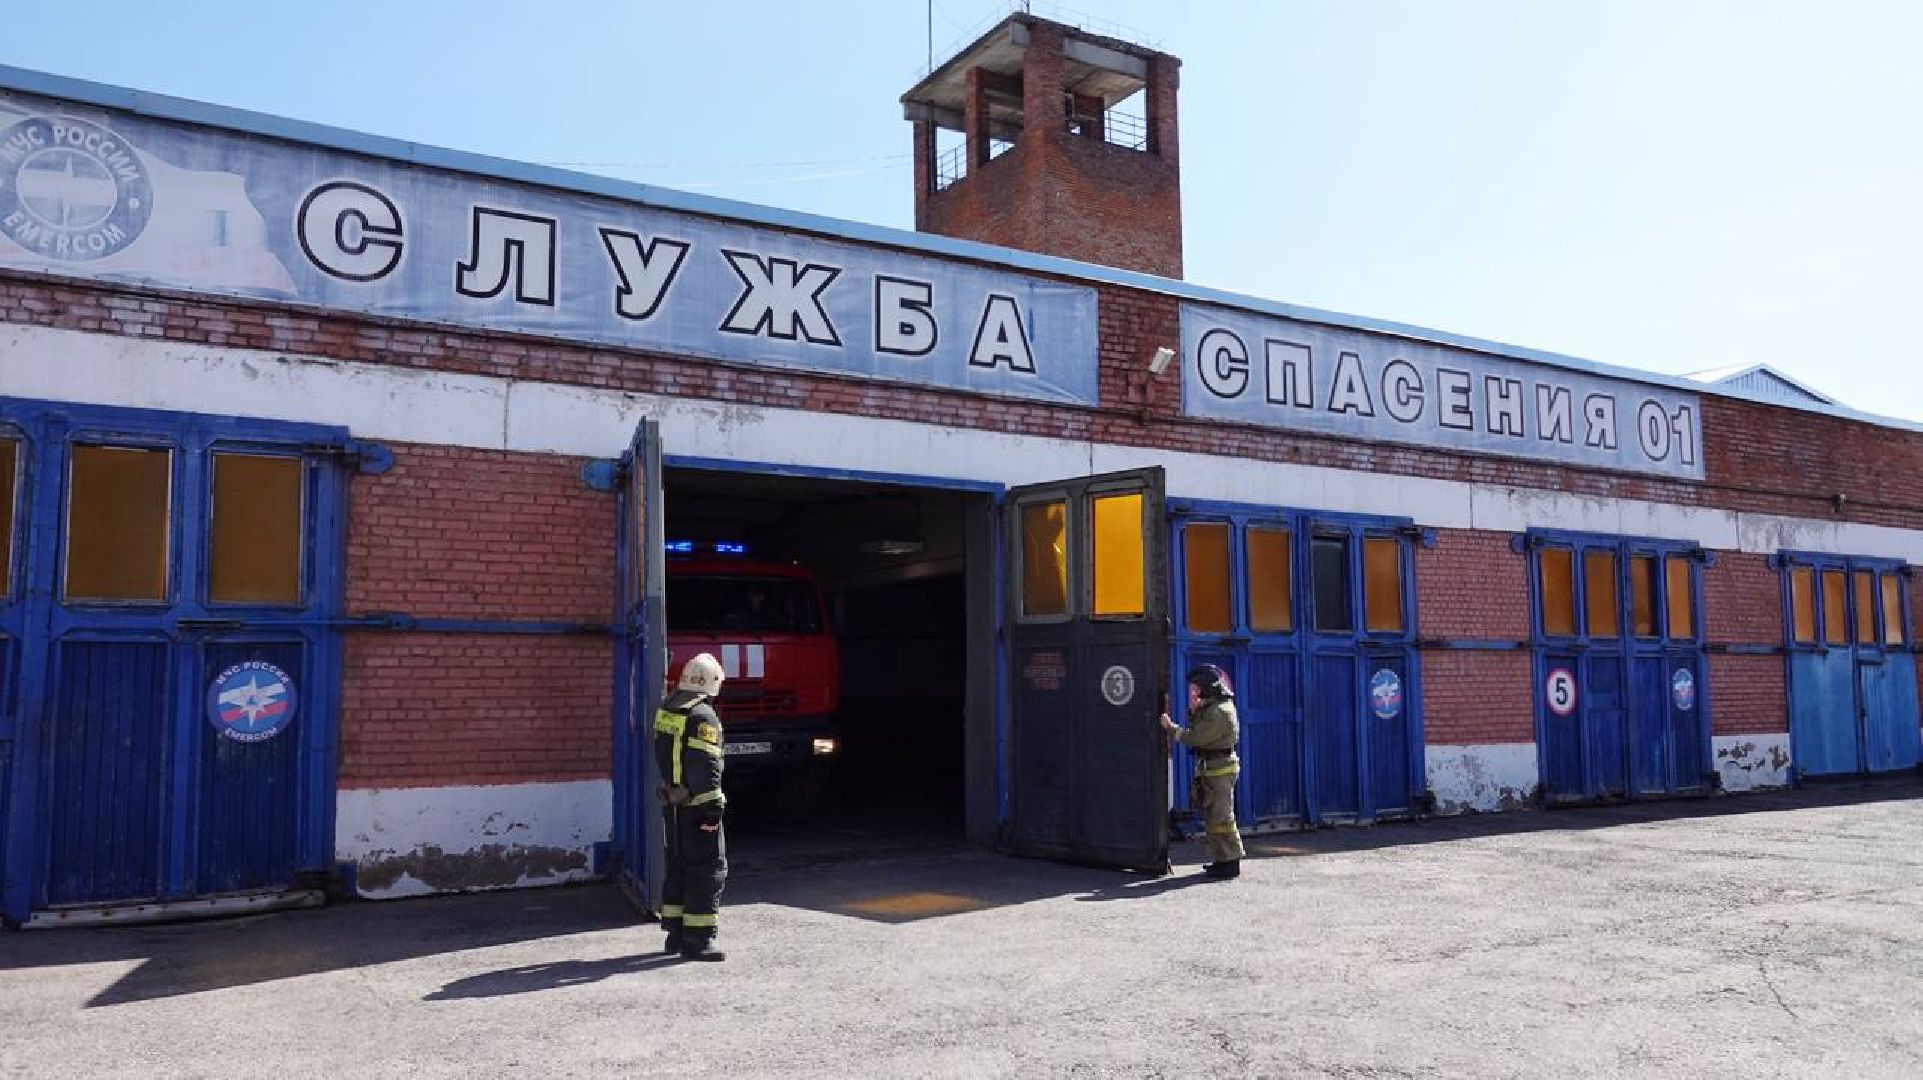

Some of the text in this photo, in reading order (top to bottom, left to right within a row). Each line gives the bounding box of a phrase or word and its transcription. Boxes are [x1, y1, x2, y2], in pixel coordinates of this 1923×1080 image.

[0, 123, 140, 181] МЧС РОССИИ
[3, 210, 127, 253] EMERCOM
[297, 179, 1036, 374] СЛУЖБА
[1197, 327, 1695, 466] СПАСЕНИЯ 01
[243, 661, 290, 684] РОССИИ
[1113, 673, 1125, 697] 3
[1555, 677, 1569, 705] 5
[224, 727, 278, 742] EMERCOM
